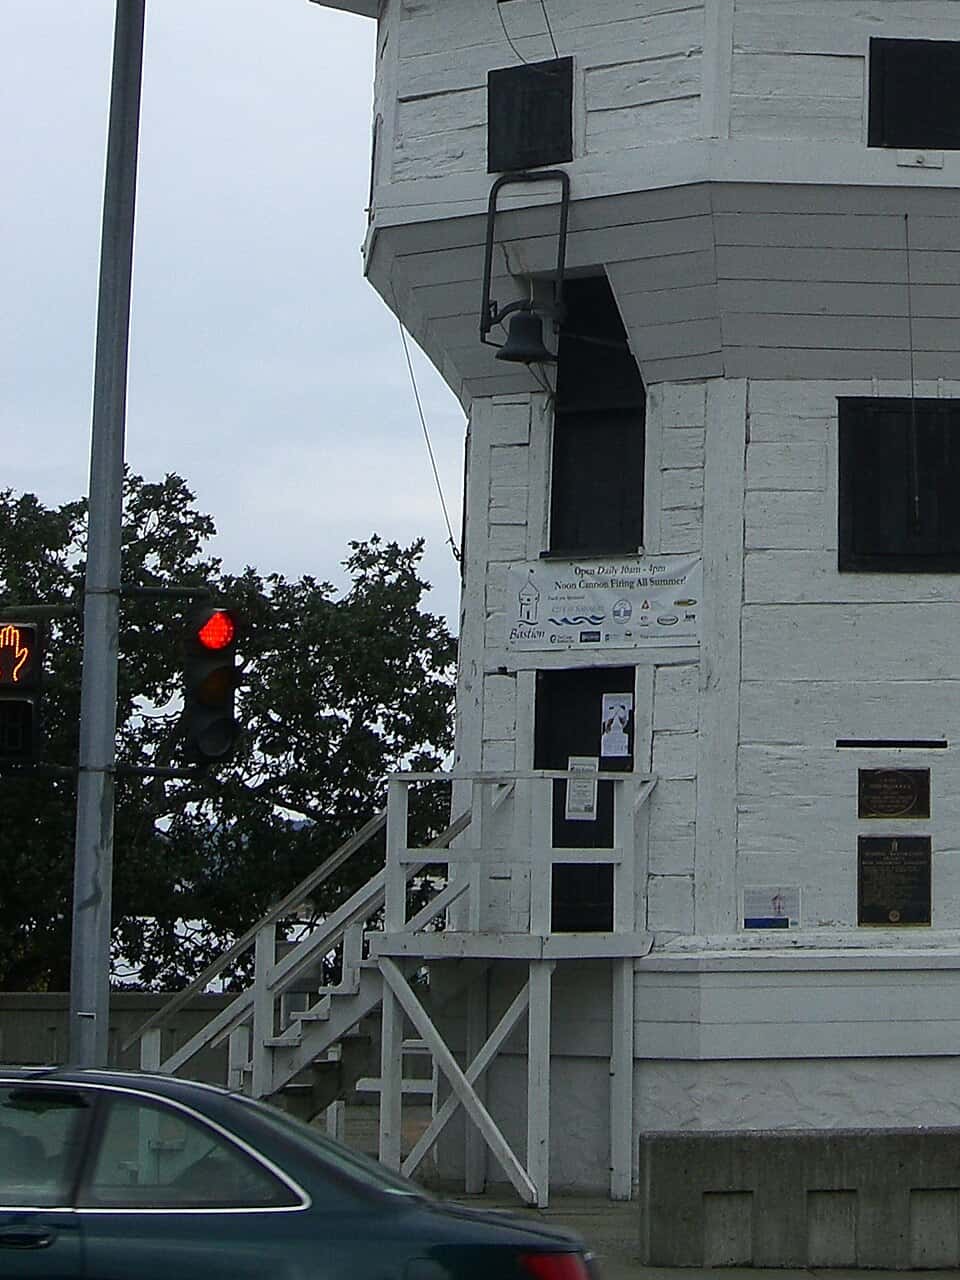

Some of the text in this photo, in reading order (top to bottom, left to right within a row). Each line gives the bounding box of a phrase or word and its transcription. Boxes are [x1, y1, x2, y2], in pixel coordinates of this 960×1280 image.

[574, 566, 595, 578] Open
[597, 566, 618, 577] Daily
[554, 576, 687, 590] Noon Cannon Firing All Summer!
[509, 626, 545, 640] Bastion
